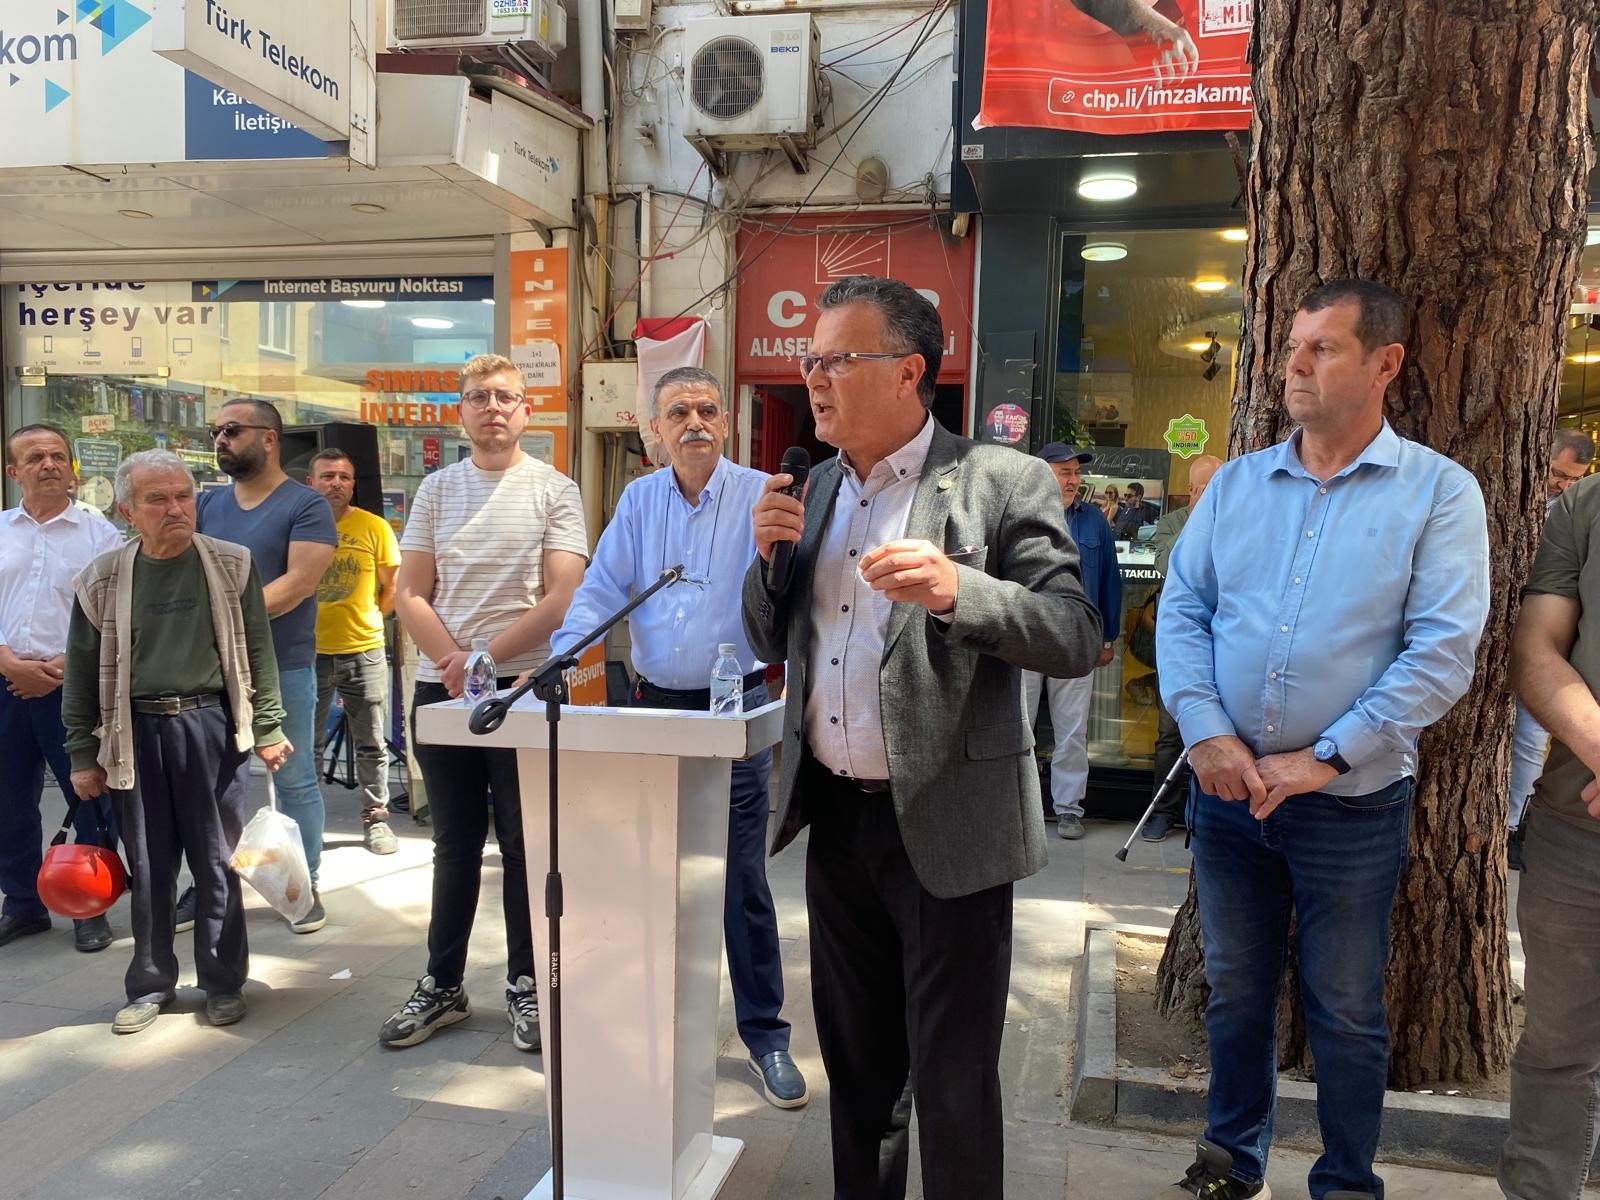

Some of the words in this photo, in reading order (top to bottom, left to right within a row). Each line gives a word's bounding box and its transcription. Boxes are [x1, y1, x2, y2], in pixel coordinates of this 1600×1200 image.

[206, 0, 252, 49] Türk
[259, 30, 339, 101] Telekom
[264, 280, 327, 294] Internet
[331, 279, 395, 296] Başvuru
[400, 278, 464, 293] Noktası
[19, 302, 141, 332] herşey
[154, 306, 214, 325] var
[1176, 430, 1198, 441] %50
[571, 660, 605, 688] Başvuru
